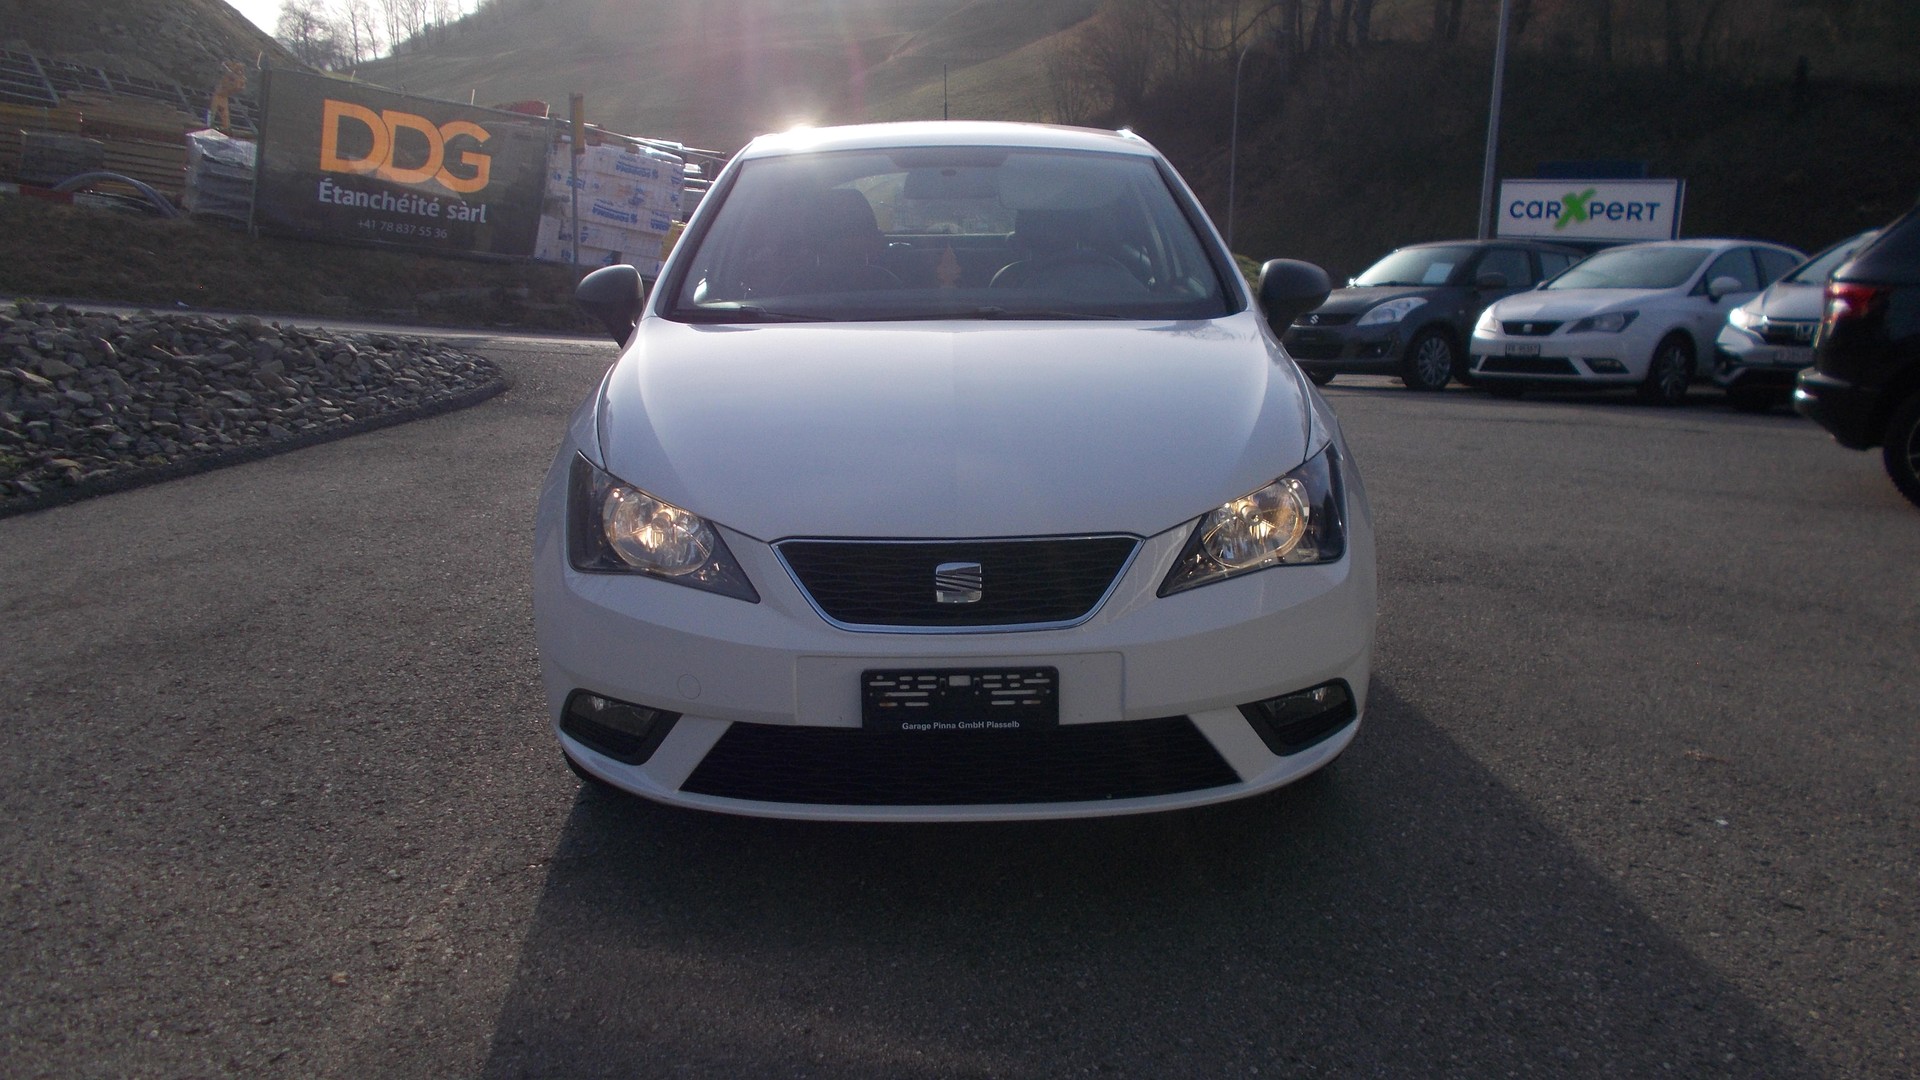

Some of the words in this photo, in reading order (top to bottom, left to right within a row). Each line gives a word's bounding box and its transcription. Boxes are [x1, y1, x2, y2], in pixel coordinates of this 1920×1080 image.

[320, 98, 492, 194] DDG
[318, 178, 441, 217] Étanchéité
[446, 200, 487, 224] sàrl
[357, 219, 376, 230] +41
[380, 220, 393, 232] 78
[396, 222, 416, 234] 837
[418, 225, 432, 237] 55
[434, 227, 448, 239] 36
[902, 722, 932, 731] Garage
[933, 722, 956, 730] Pinna
[958, 721, 985, 730] GmbH
[986, 720, 1020, 730] Plasselb
